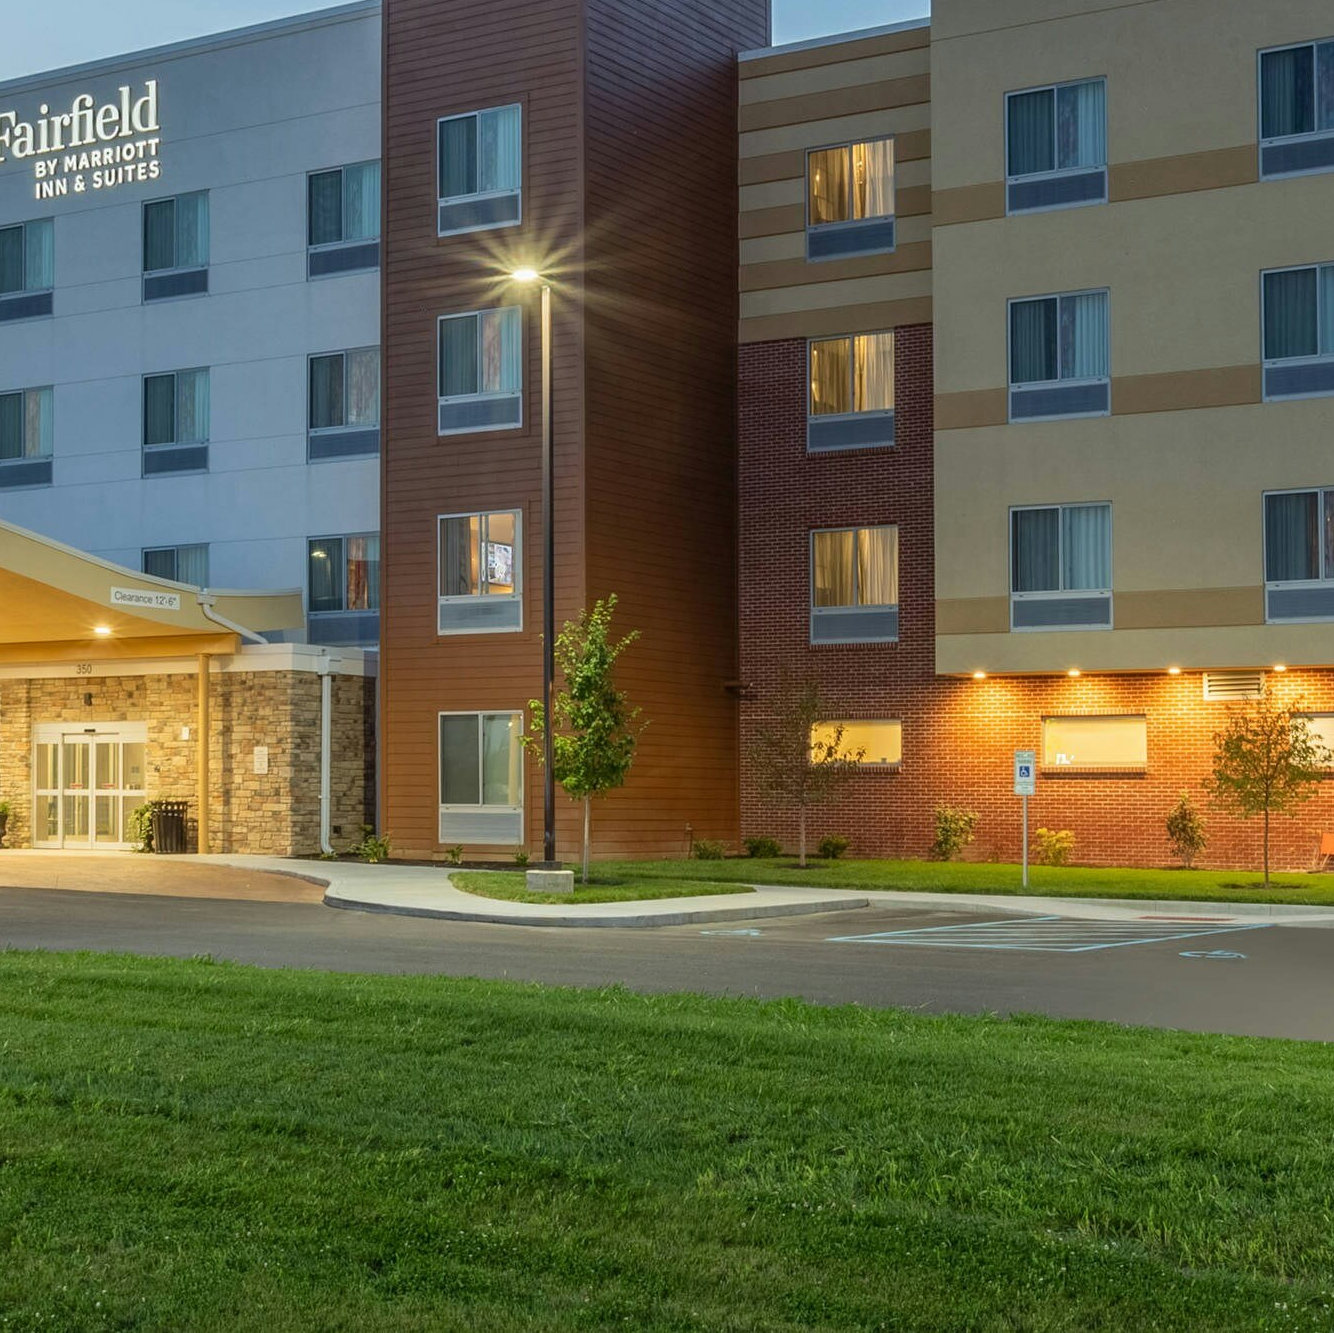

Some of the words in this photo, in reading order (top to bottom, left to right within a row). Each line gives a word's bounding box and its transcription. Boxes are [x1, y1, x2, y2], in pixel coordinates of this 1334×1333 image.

[35, 158, 58, 178] BY
[64, 138, 160, 173] MARRIOTT
[35, 177, 67, 199] INN
[74, 174, 85, 192] &
[92, 160, 160, 189] SUITES
[114, 590, 153, 604] Clearance
[76, 664, 92, 675] 350
